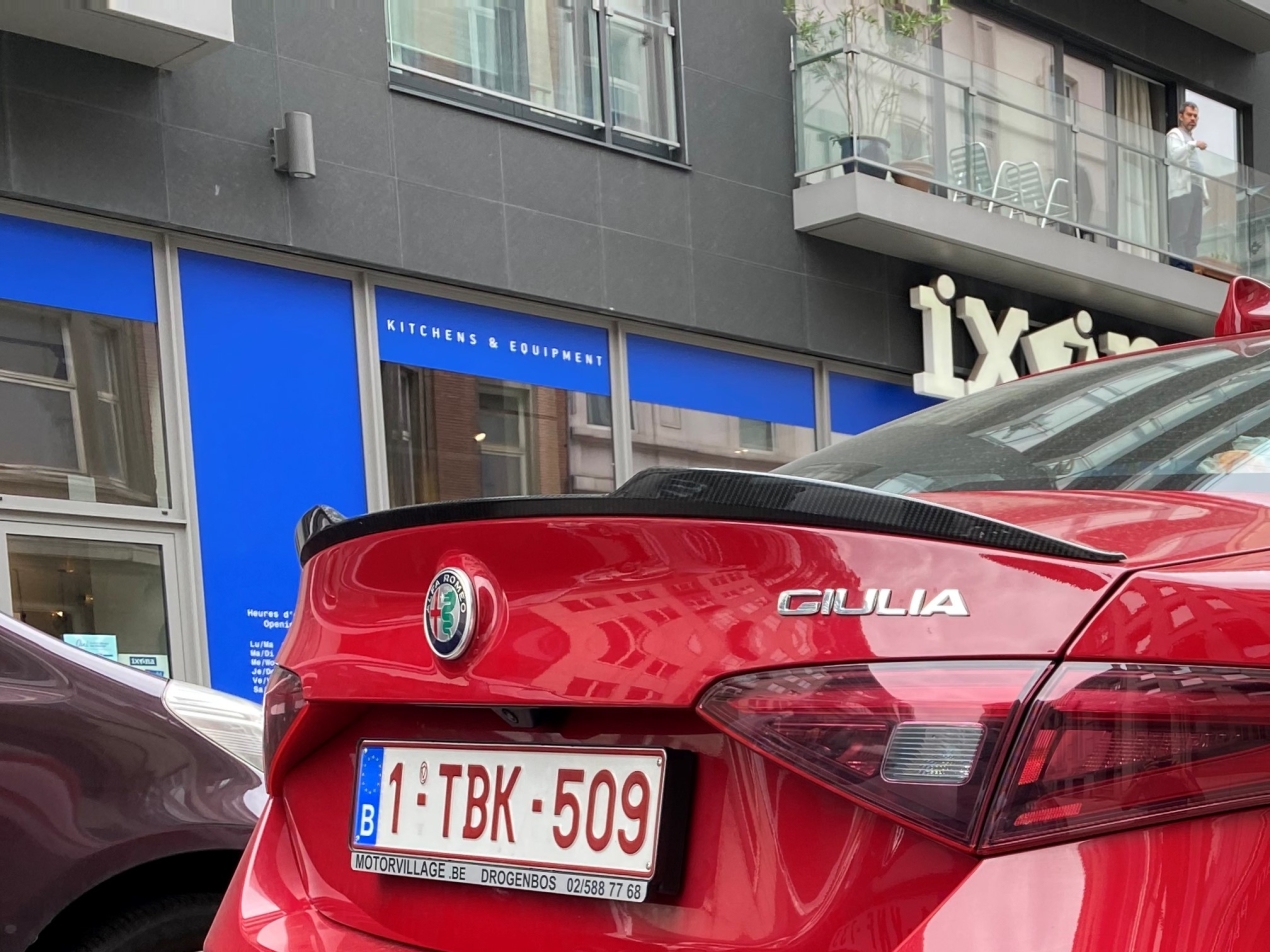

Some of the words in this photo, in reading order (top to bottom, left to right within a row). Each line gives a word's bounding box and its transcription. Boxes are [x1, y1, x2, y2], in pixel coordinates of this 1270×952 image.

[386, 319, 477, 345] KITCHENS
[488, 337, 499, 349] &
[510, 341, 603, 366] EQUIPMENT
[426, 579, 440, 614] ALFA
[443, 573, 467, 613] ROMEO
[777, 588, 970, 616] GIULIA
[247, 609, 279, 618] Heures
[360, 803, 375, 837] B
[355, 854, 446, 879] MOTORVILLAGE
[481, 868, 557, 891] DROGENBOS
[566, 877, 605, 896] 02/588
[608, 881, 623, 898] 77
[626, 883, 641, 900] 68
